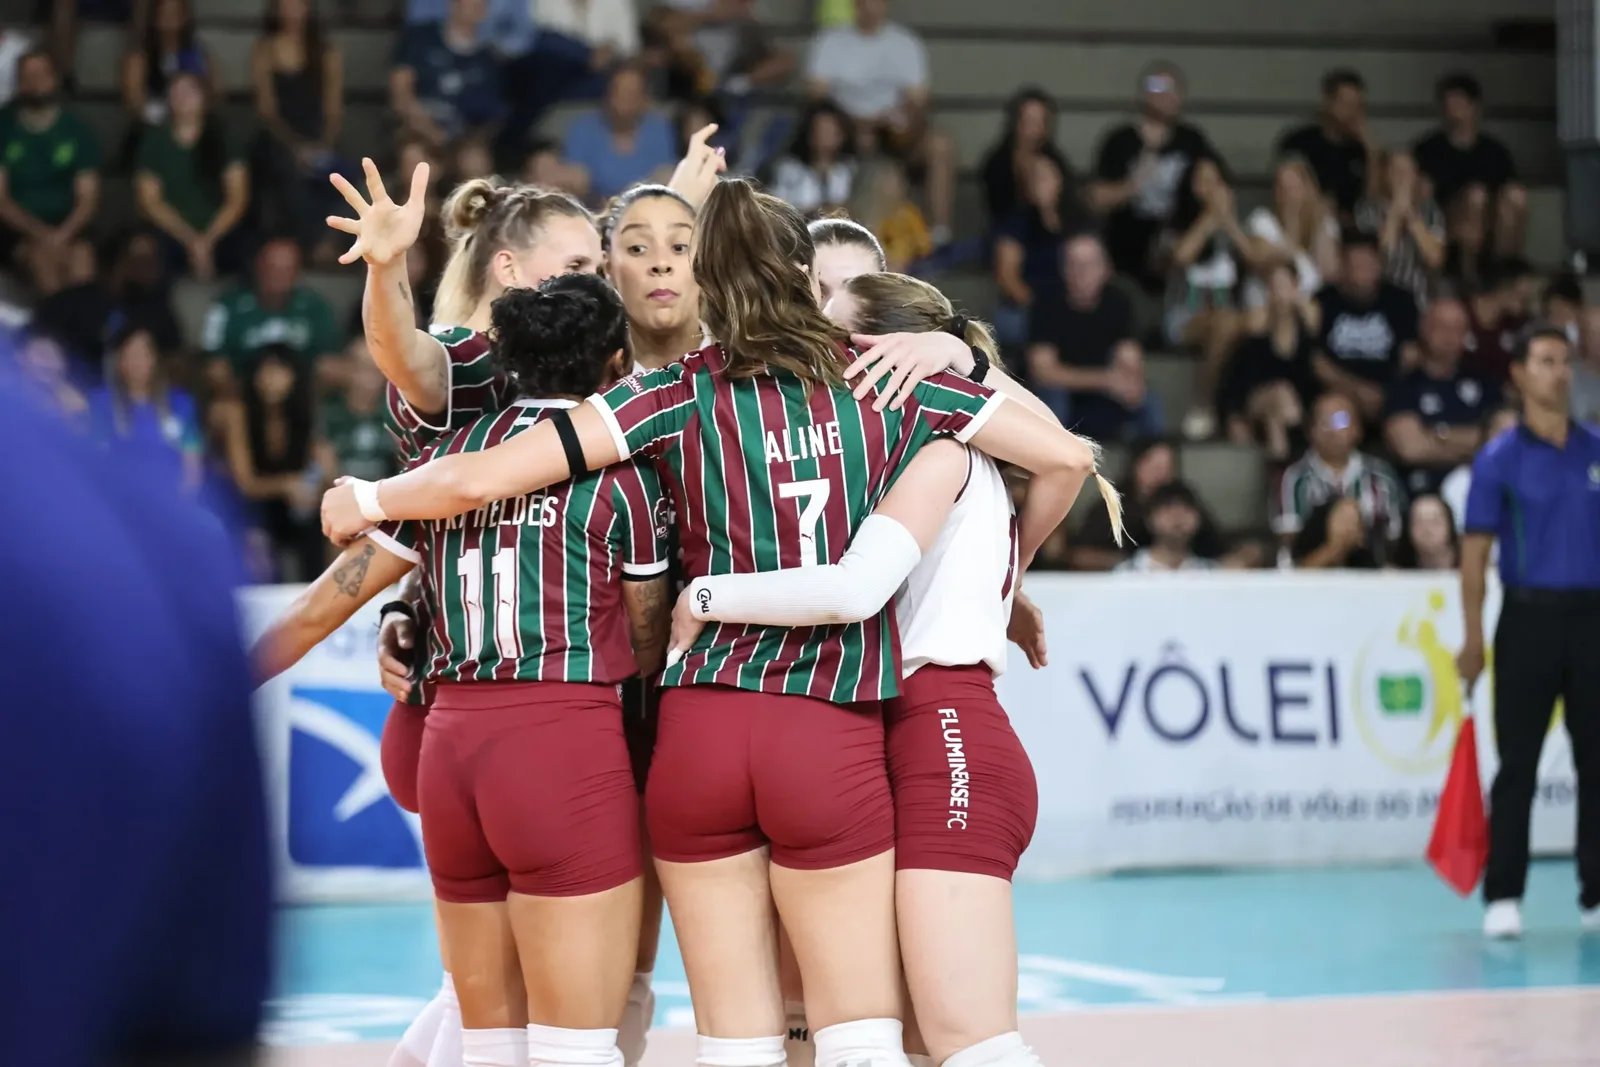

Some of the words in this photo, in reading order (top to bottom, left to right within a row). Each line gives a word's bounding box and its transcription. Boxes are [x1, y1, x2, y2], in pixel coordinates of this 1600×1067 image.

[765, 421, 844, 464] ALINE
[778, 478, 831, 567] 7
[457, 547, 519, 661] 11
[1078, 638, 1341, 745] VÔLEI
[937, 708, 969, 808] FLUMINENSE
[946, 810, 968, 830] FC
